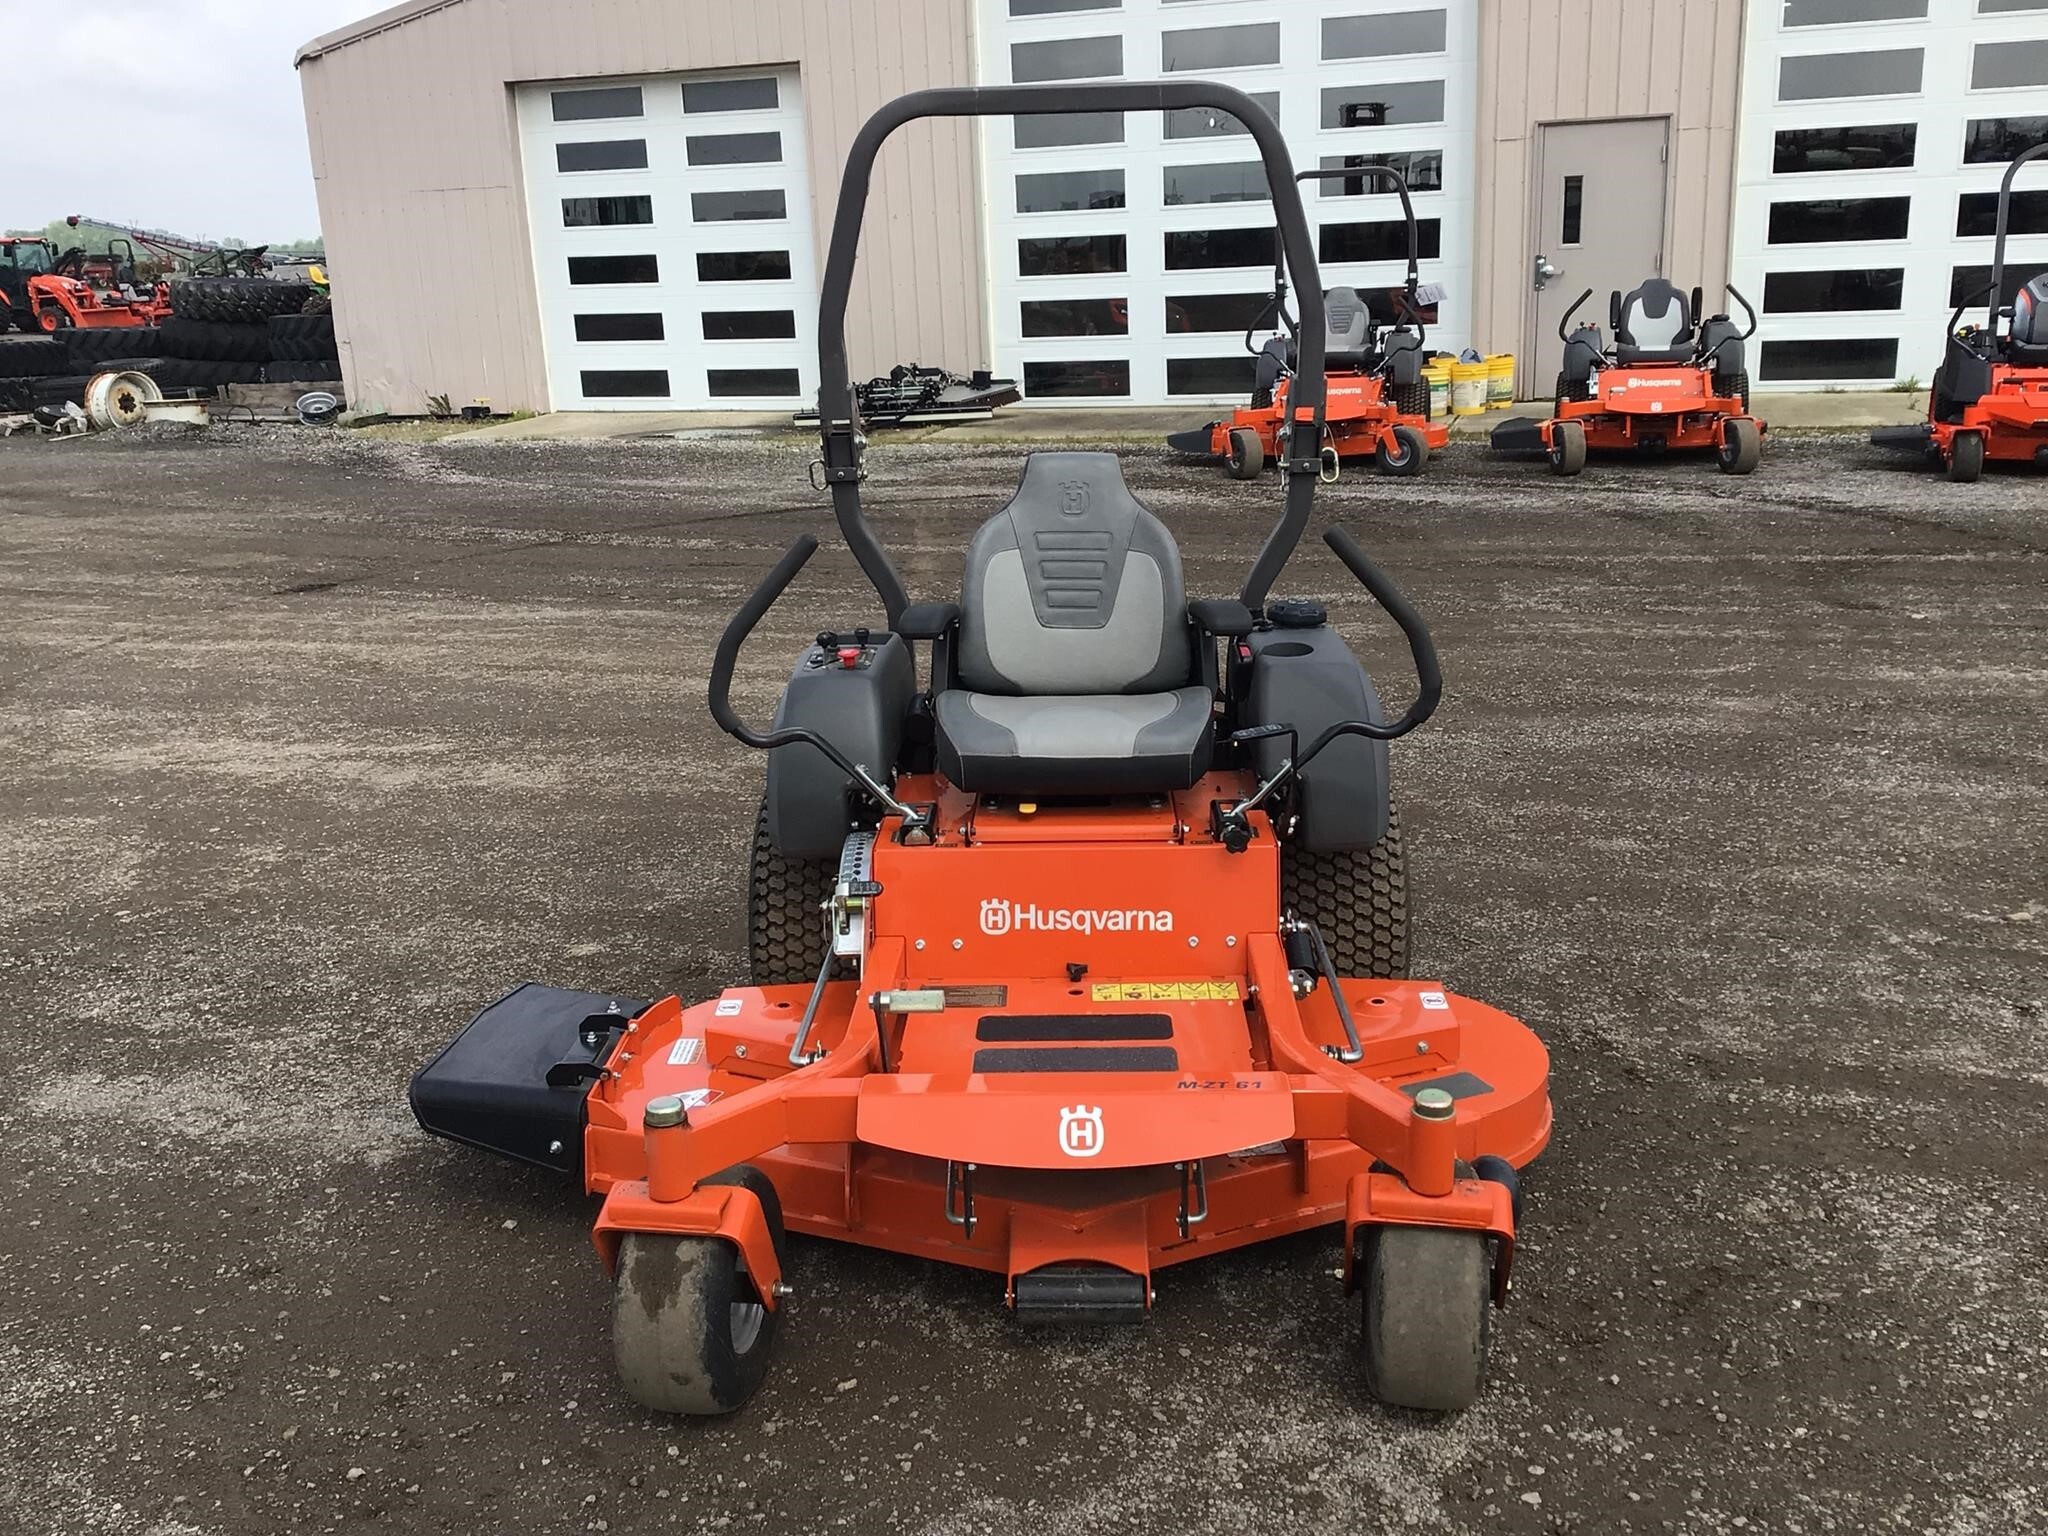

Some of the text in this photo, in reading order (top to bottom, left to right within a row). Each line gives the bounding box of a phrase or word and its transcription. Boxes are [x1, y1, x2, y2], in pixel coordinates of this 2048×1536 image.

[1326, 387, 1362, 396] usqvarna
[1014, 903, 1173, 935] Husqvarna
[1177, 1080, 1262, 1089] M-ZT 61
